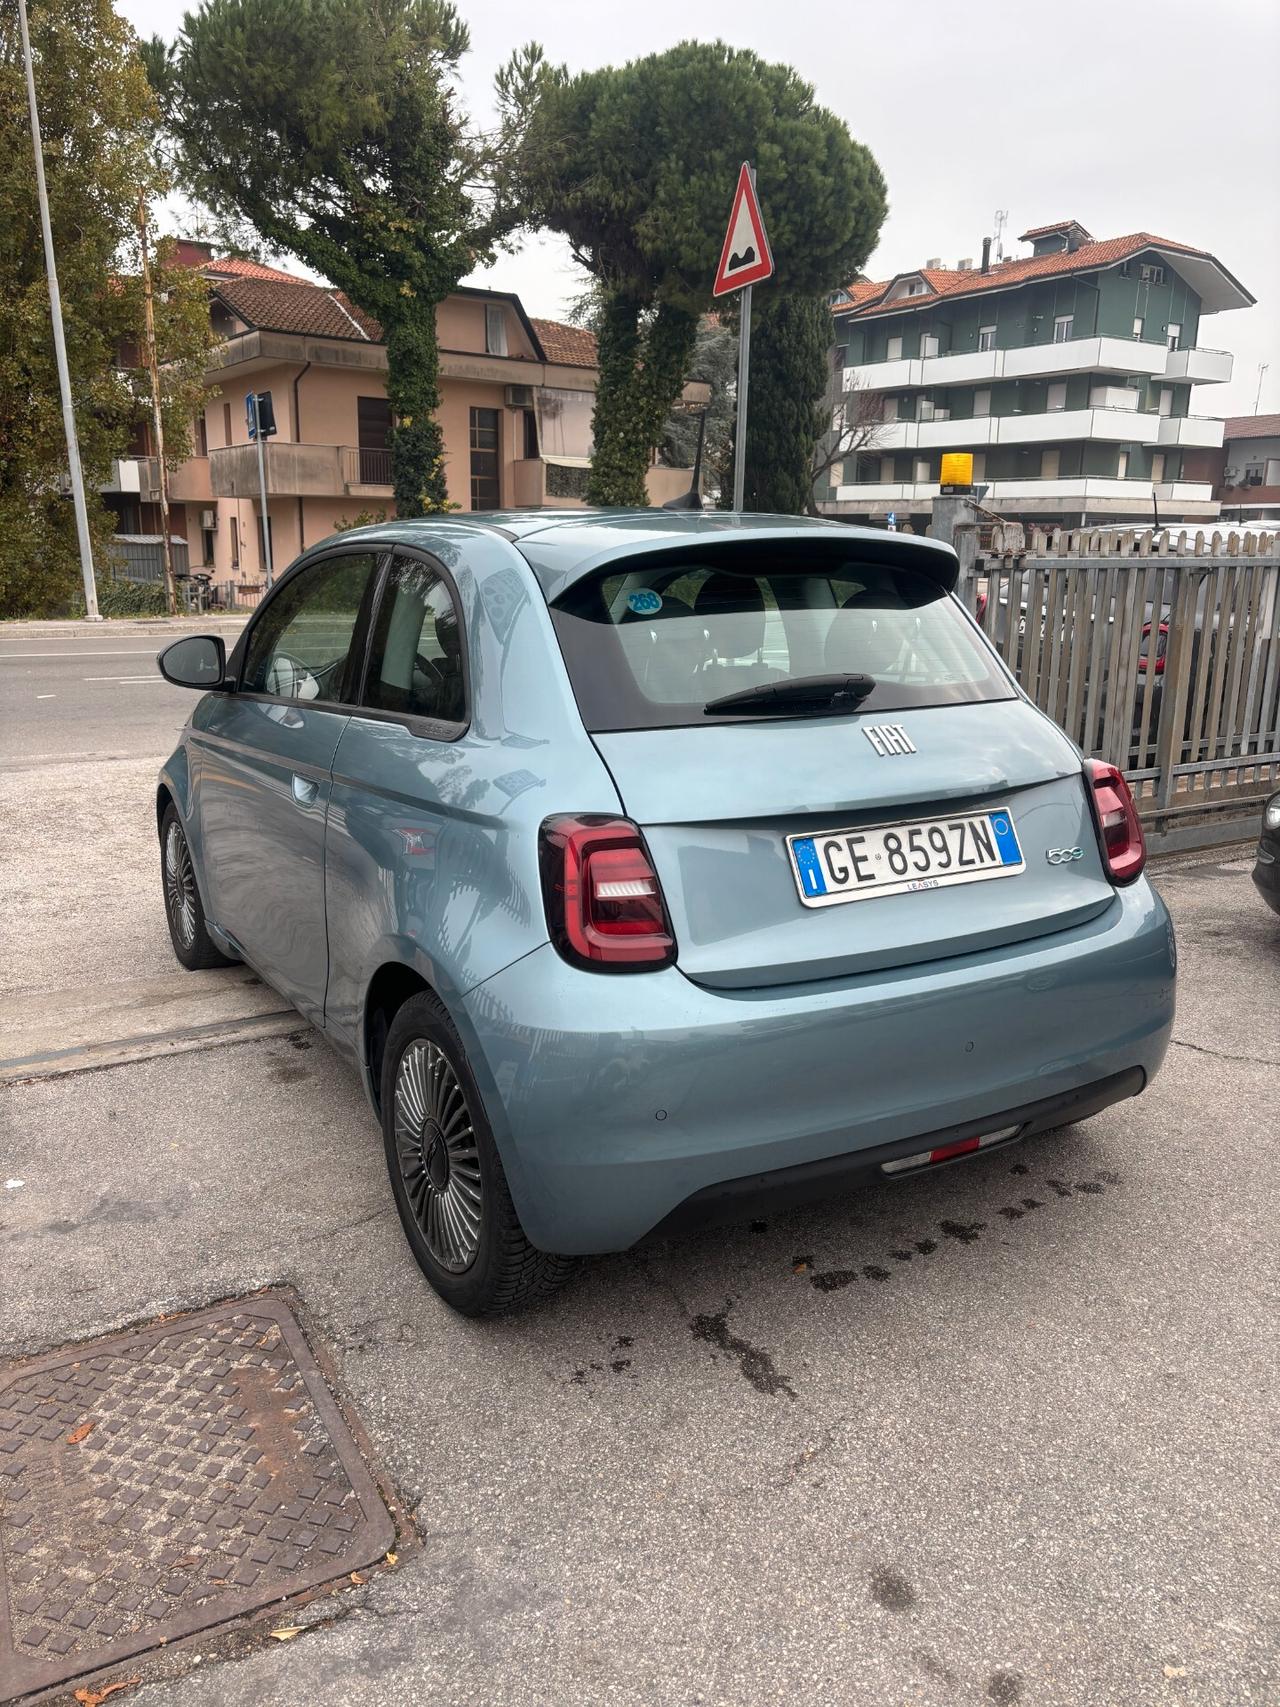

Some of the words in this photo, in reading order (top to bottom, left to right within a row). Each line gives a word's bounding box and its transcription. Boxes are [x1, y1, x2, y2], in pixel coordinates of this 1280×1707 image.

[861, 724, 917, 757] FIAT
[823, 836, 875, 885] GE
[883, 819, 996, 875] 859ZN
[906, 879, 939, 891] LEASYS
